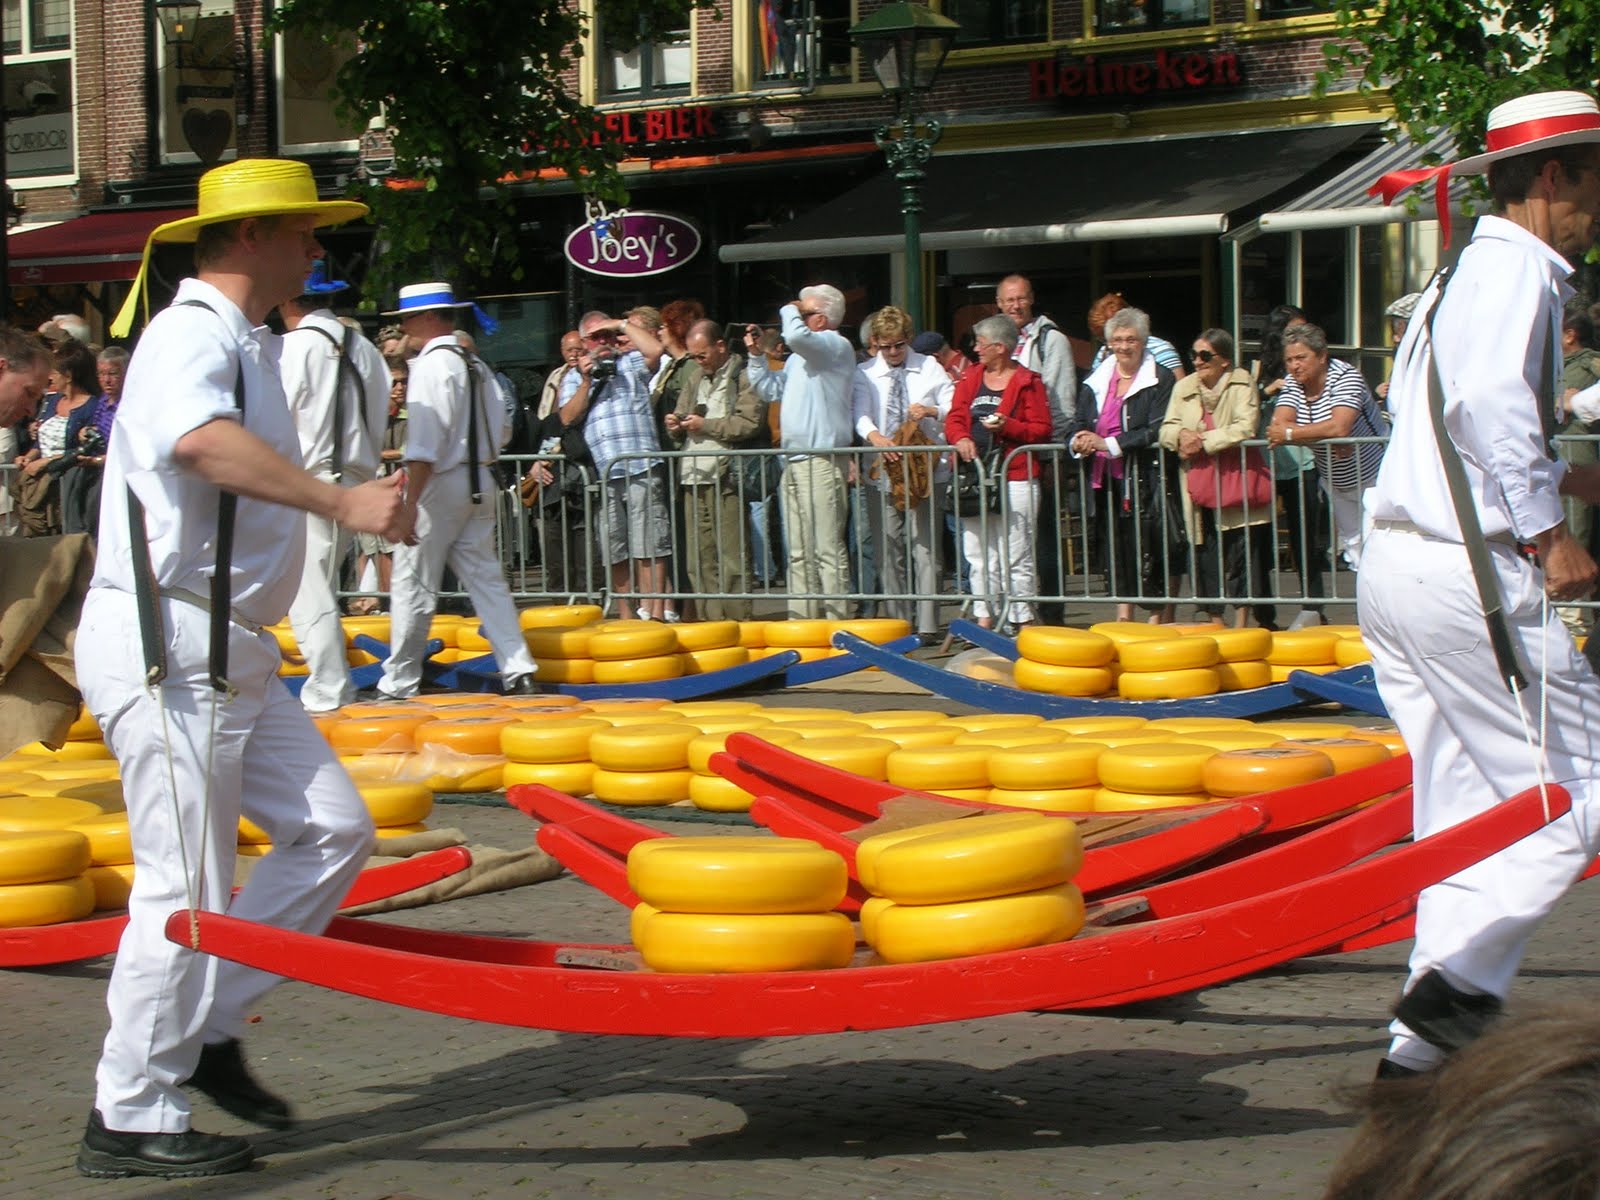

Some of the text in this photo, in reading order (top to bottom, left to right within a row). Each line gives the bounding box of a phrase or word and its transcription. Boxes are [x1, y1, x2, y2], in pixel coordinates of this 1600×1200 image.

[1028, 48, 1241, 101] Heineken
[646, 105, 717, 143] BIER
[587, 224, 678, 268] Joey's
